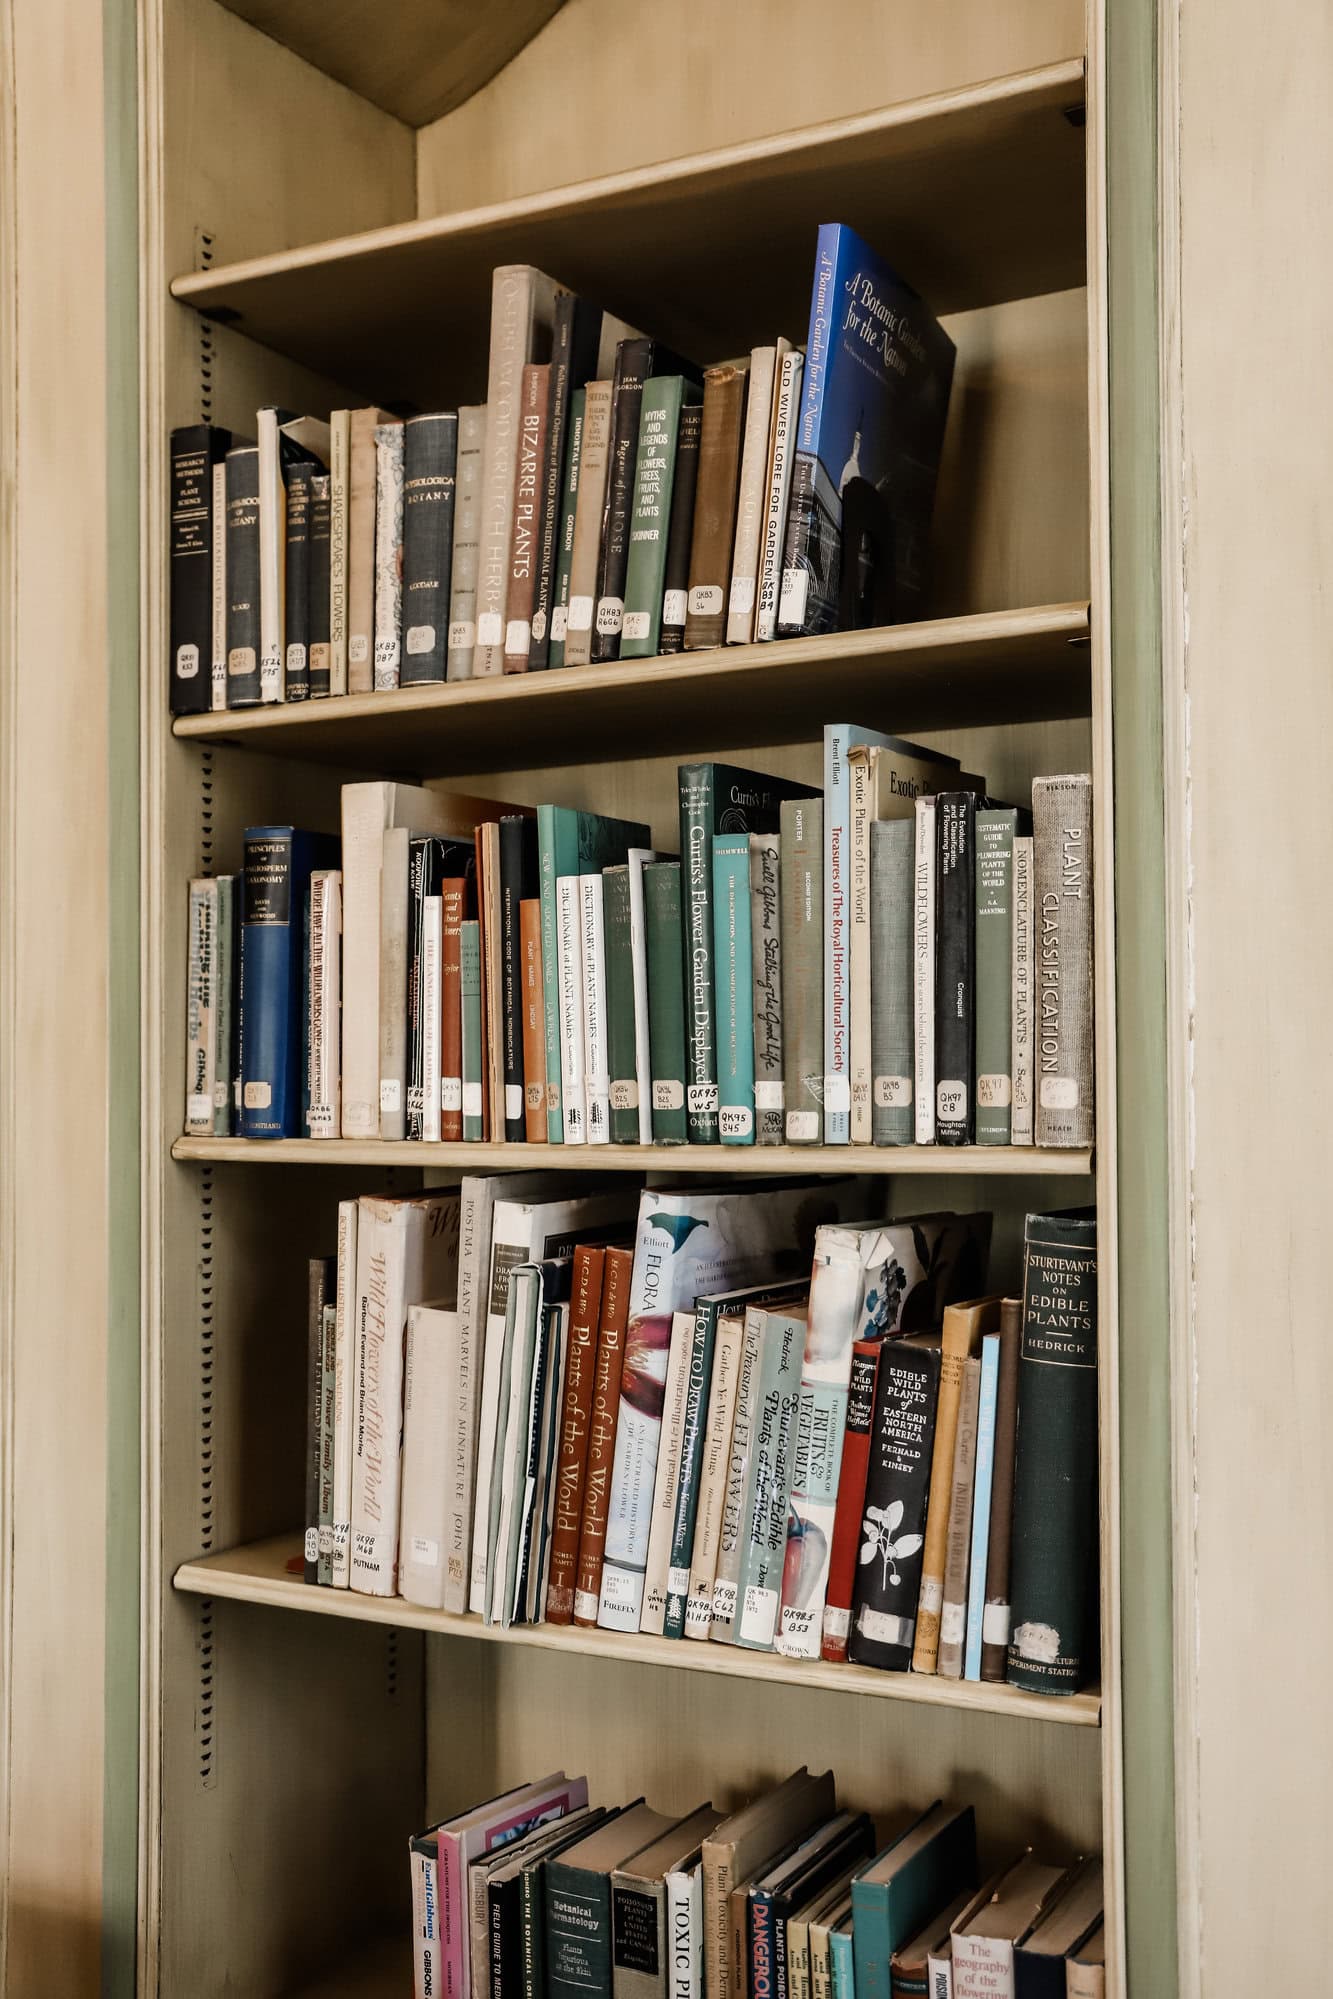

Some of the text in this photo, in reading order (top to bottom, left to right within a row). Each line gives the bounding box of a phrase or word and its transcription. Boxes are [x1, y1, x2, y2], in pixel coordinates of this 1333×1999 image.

[843, 300, 877, 346] for the
[861, 280, 898, 331] Botanic
[803, 251, 832, 445] A Botanic Garden for the Nation
[645, 410, 667, 421] MYTHS
[647, 422, 661, 433] AND
[640, 434, 668, 446] LEGENDS
[647, 446, 656, 457] OF
[771, 360, 792, 513] OLD WIVES' LORE FOR
[180, 488, 198, 497] PLANT
[513, 415, 540, 580] BIZARRE PLANTS
[564, 417, 582, 551] IMMORTAL ROSES GORDON
[641, 495, 654, 505] AND
[542, 468, 557, 575] FOOD AND MEDICINAL
[636, 507, 659, 517] PLANTS
[610, 511, 625, 554] ROSE
[632, 530, 659, 541] SKINNER
[332, 583, 344, 642] FLOWERS
[832, 738, 840, 785] Brent Elliott
[943, 804, 950, 813] of
[855, 766, 866, 924] Exotic Plants of the World
[942, 815, 950, 850] Flowering
[1062, 828, 1083, 900] PLANT
[543, 880, 551, 899] AND
[917, 862, 928, 959] WILDFLOWERS
[561, 888, 574, 1039] DICTIONARY PLANT NAMES
[584, 885, 597, 1038] DICTIONARY PLANT NAMES
[690, 826, 711, 1084] Curtis's Flower Garden Displayed
[830, 826, 844, 1073] Treasures of The Royal Horticultural Society
[1016, 850, 1027, 1044] NOMENCLATURE OF PLANTS
[956, 982, 965, 1017] Cronquist
[1041, 892, 1059, 1073] CLASSIFICATION
[690, 1088, 718, 1099] QK95
[721, 1112, 746, 1123] QK95
[937, 1121, 966, 1129] Houghton
[643, 1236, 669, 1249] Elliott
[1029, 1255, 1097, 1273] STURTEVANT'S
[1042, 1271, 1081, 1286] NOTES
[642, 1254, 662, 1311] FLORA
[1052, 1287, 1067, 1295] ON
[1027, 1311, 1091, 1329] PLANTS
[1031, 1294, 1089, 1312] EDIBLE
[745, 1321, 762, 1346] The
[777, 1327, 794, 1375] Hedrick
[1028, 1338, 1085, 1353] HEDRICK
[453, 1200, 475, 1551] POSTMA PLANT MARVELS IN MINIATURE JOHN
[712, 1344, 733, 1432] Gather Wild
[851, 1382, 873, 1392] PLANTS
[854, 1375, 871, 1384] WILD
[890, 1367, 927, 1382] EDIBLE
[893, 1378, 921, 1391] WILD
[680, 1306, 710, 1483] HOW DRAW PLANTS
[887, 1386, 927, 1403] PLANTS
[900, 1400, 912, 1410] of
[557, 1326, 591, 1531] Plants of the World
[583, 1329, 619, 1536] Plants of the World
[758, 1390, 780, 1445] Plants
[883, 1407, 927, 1424] EASTERN
[886, 1417, 922, 1432] NORTH
[322, 1387, 333, 1514] Flower Album
[792, 1394, 814, 1488] VEGETABLES
[809, 1408, 830, 1479] FRUITS &
[881, 1427, 922, 1442] AMERICA
[881, 1444, 921, 1458] FERNALD
[662, 1460, 677, 1508] Botanical
[767, 1496, 786, 1551] Edible
[353, 1558, 380, 1572] PUTNAM
[603, 1600, 637, 1614] FIREFLY
[524, 1902, 532, 1919] THE
[553, 1900, 592, 1918] Botanical
[715, 1865, 729, 1964] Plant Toxicity and
[492, 1903, 502, 1974] FIELD GUIDE TO
[674, 1897, 690, 1969] TOXIC
[775, 1918, 784, 1961] PLANTS
[969, 1944, 991, 1957] The
[423, 1950, 432, 1997] GIBBONS
[954, 1959, 1010, 1976] geography
[964, 1974, 997, 1987] of the
